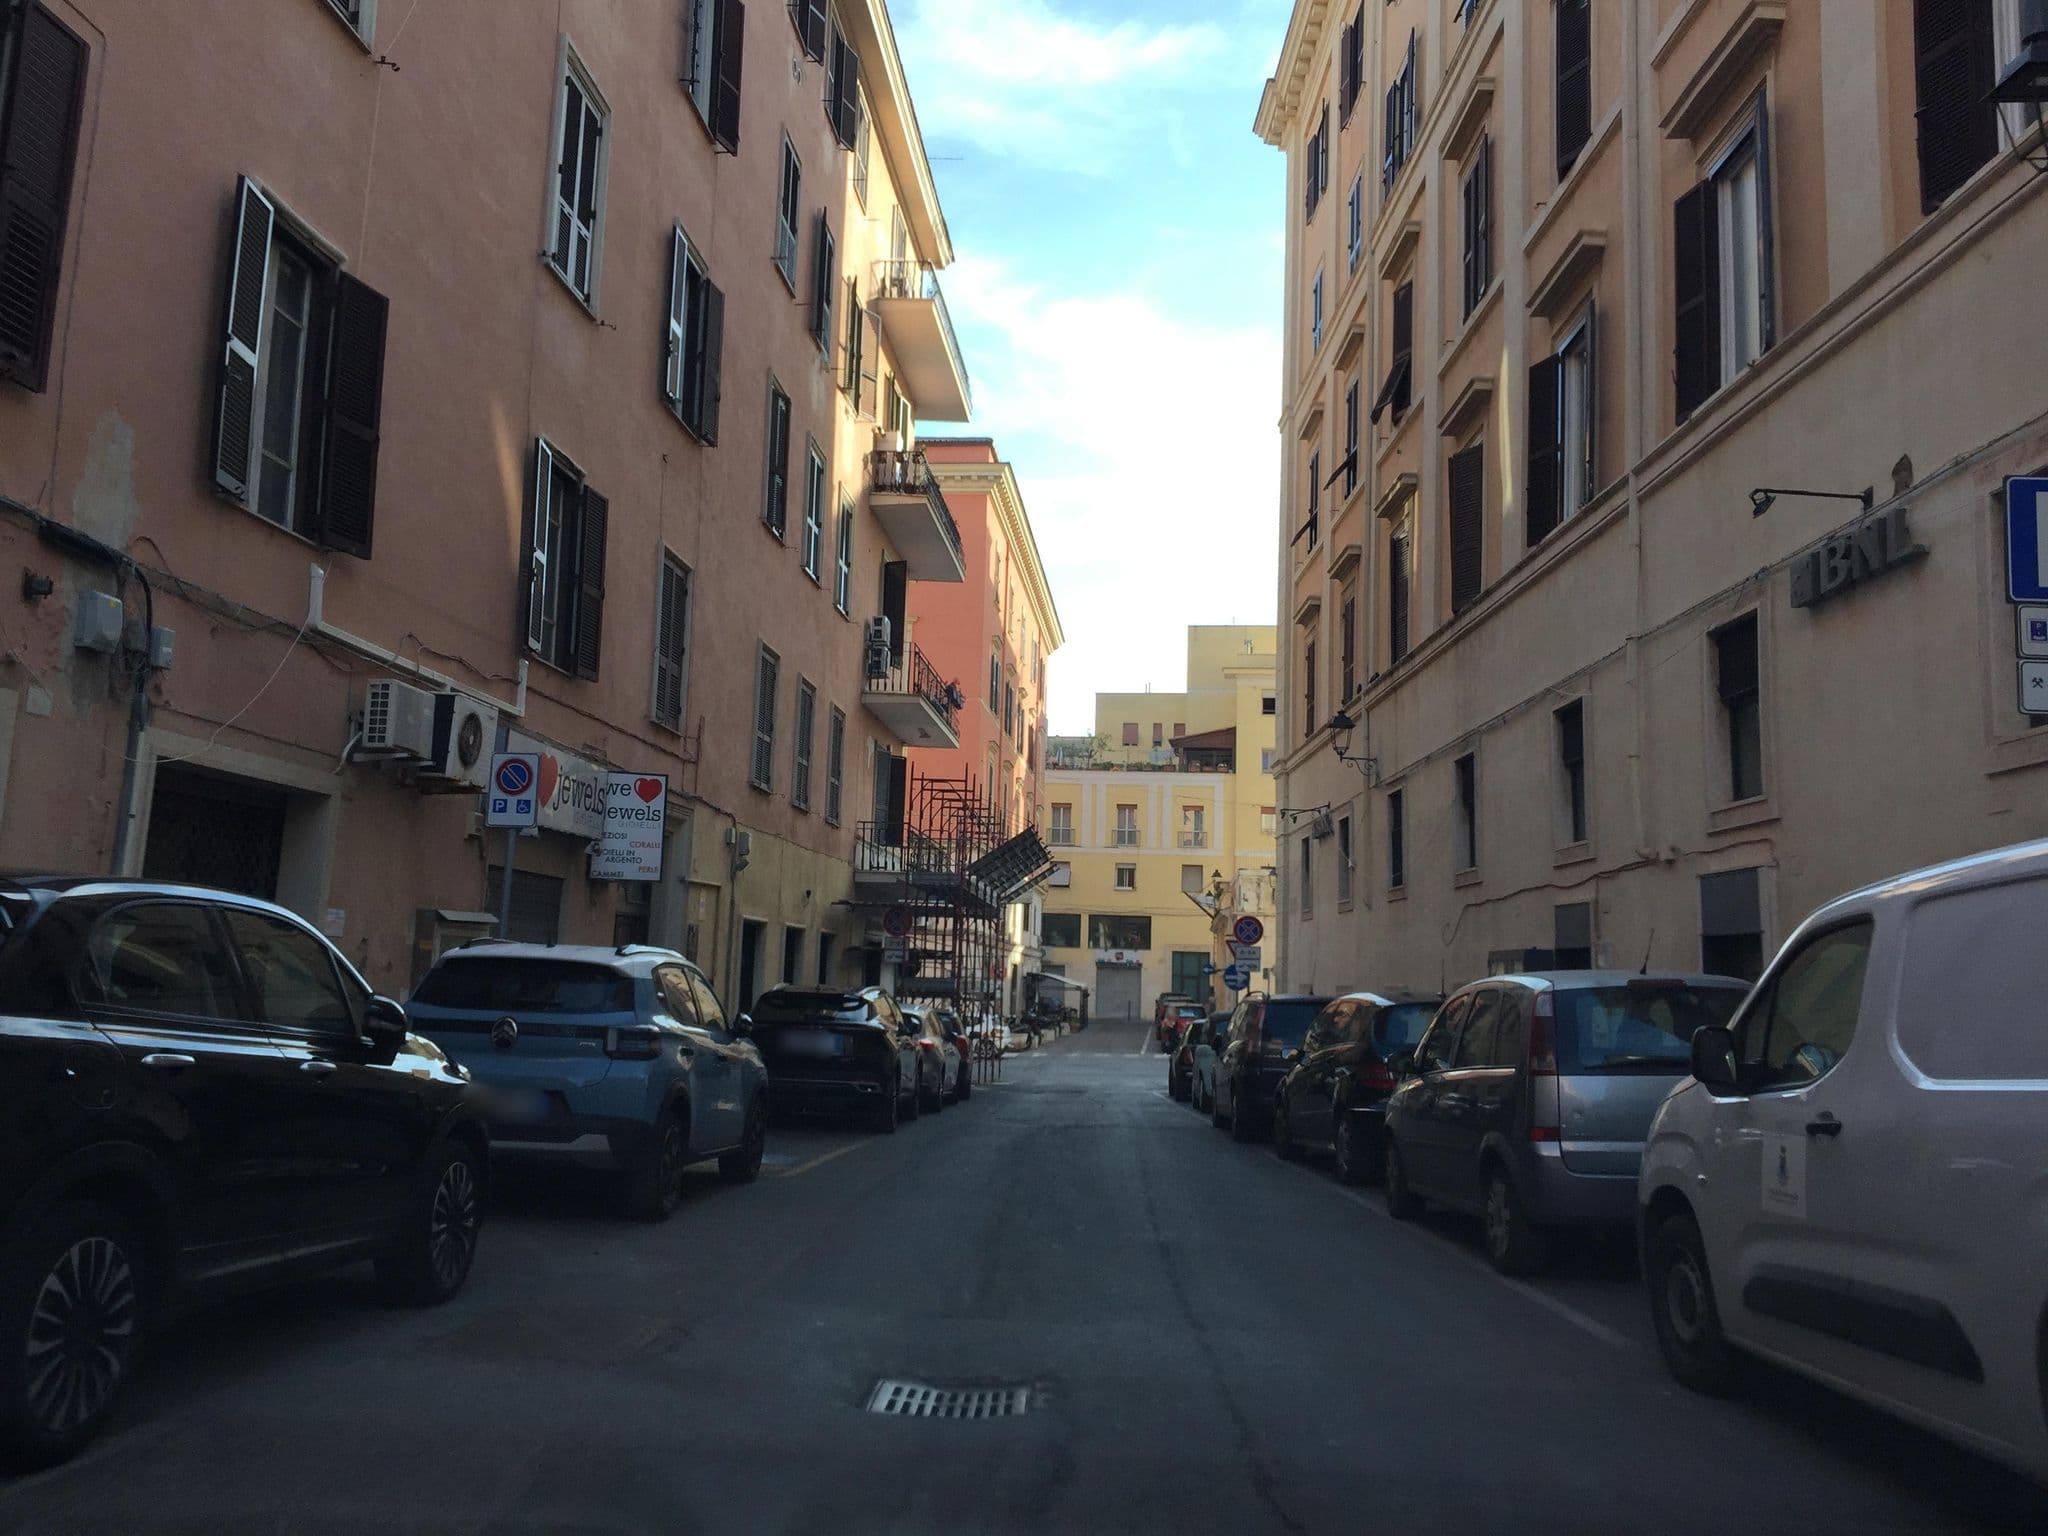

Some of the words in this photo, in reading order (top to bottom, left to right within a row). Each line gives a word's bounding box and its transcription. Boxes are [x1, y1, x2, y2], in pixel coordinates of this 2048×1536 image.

[1818, 508, 1930, 594] BNL
[553, 766, 605, 815] jewels
[495, 800, 505, 812] P
[607, 805, 662, 822] ewels
[604, 855, 643, 865] ARGENTO
